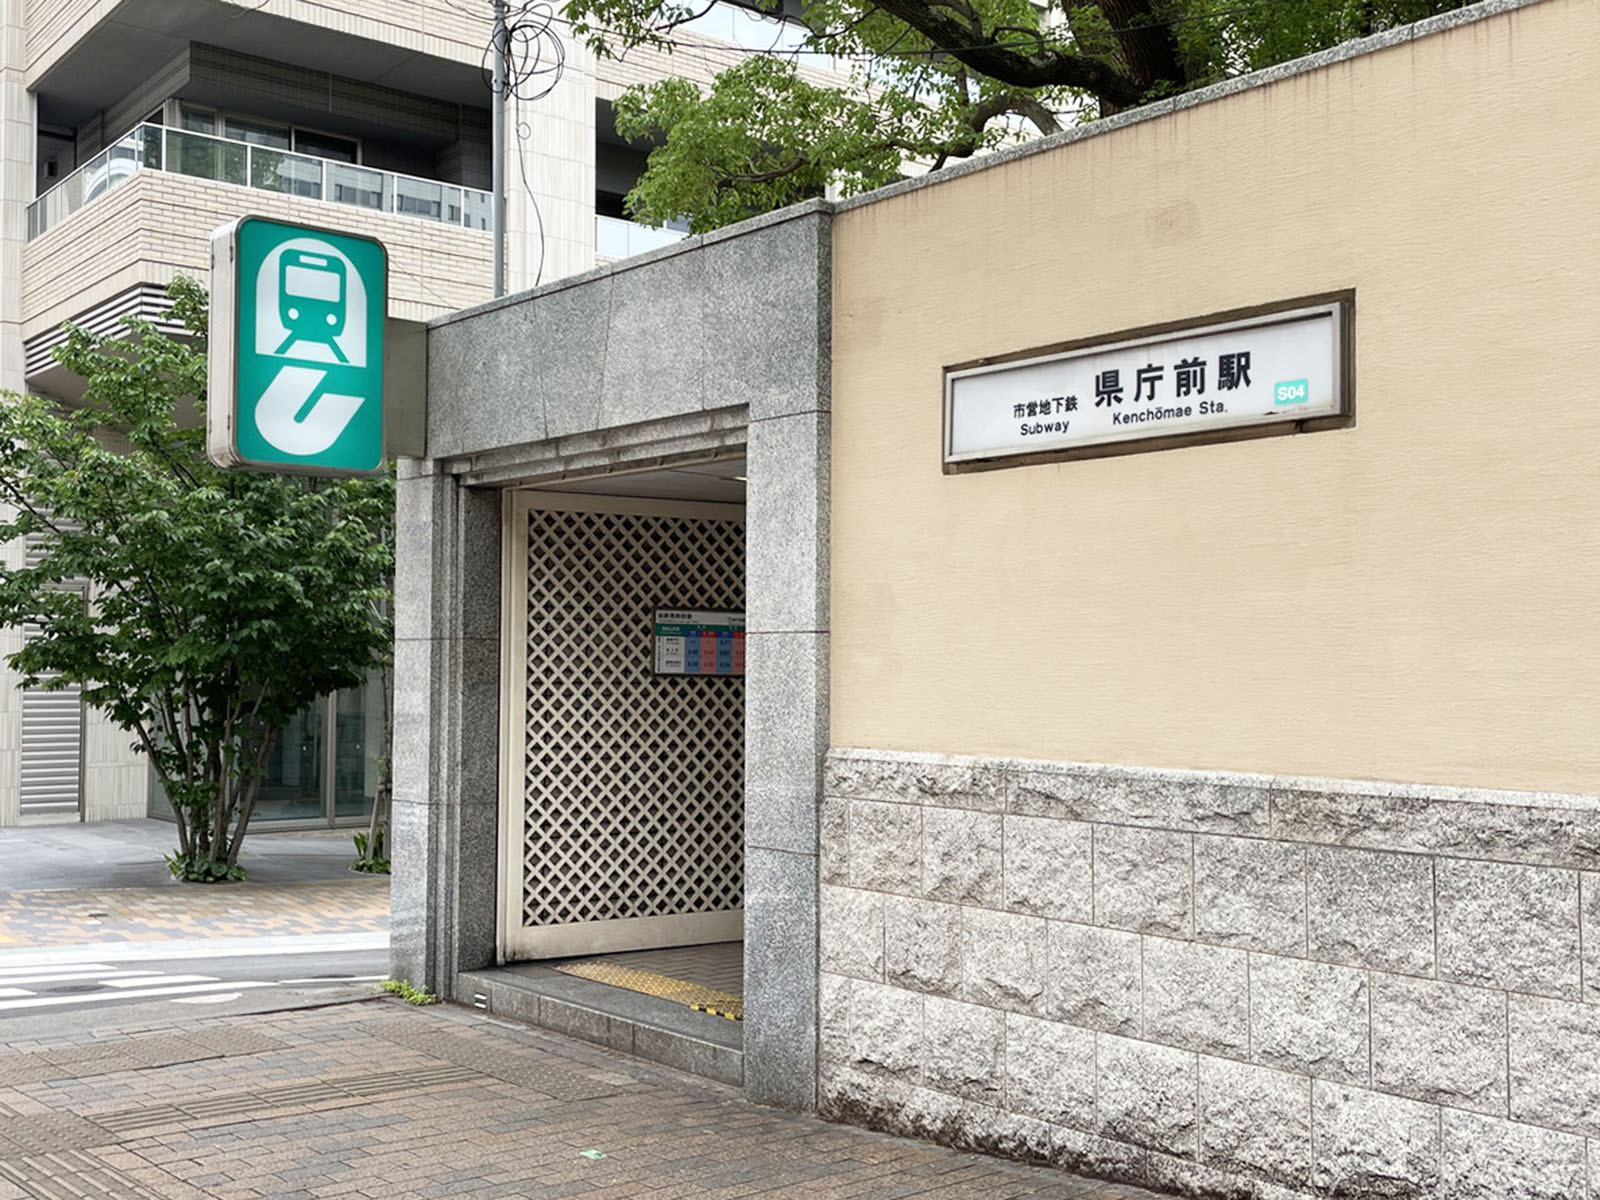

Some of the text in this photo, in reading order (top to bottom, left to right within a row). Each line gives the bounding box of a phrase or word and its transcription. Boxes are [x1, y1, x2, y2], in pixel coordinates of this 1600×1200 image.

[1013, 351, 1252, 418] 市営地下鉄 県庁前駅
[1276, 383, 1306, 402] S04
[1021, 402, 1230, 437] Subway Kenchōmae Sta.
